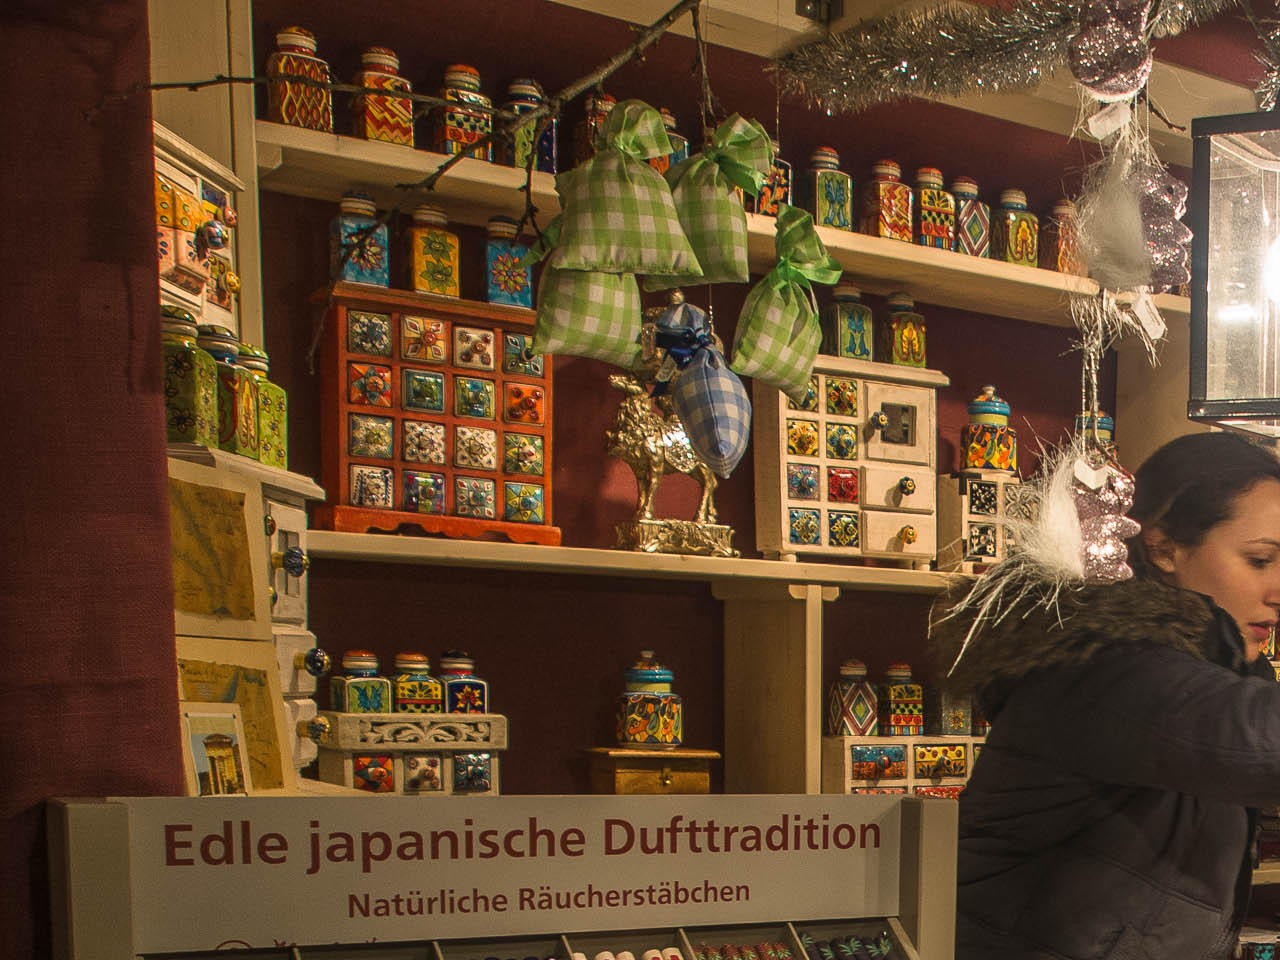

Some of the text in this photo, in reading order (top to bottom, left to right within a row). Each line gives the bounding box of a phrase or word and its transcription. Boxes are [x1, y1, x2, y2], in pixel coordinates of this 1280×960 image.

[163, 813, 881, 875] Edle japanische Dufttradition
[348, 880, 751, 919] Natürliche Räucherstäbchen
